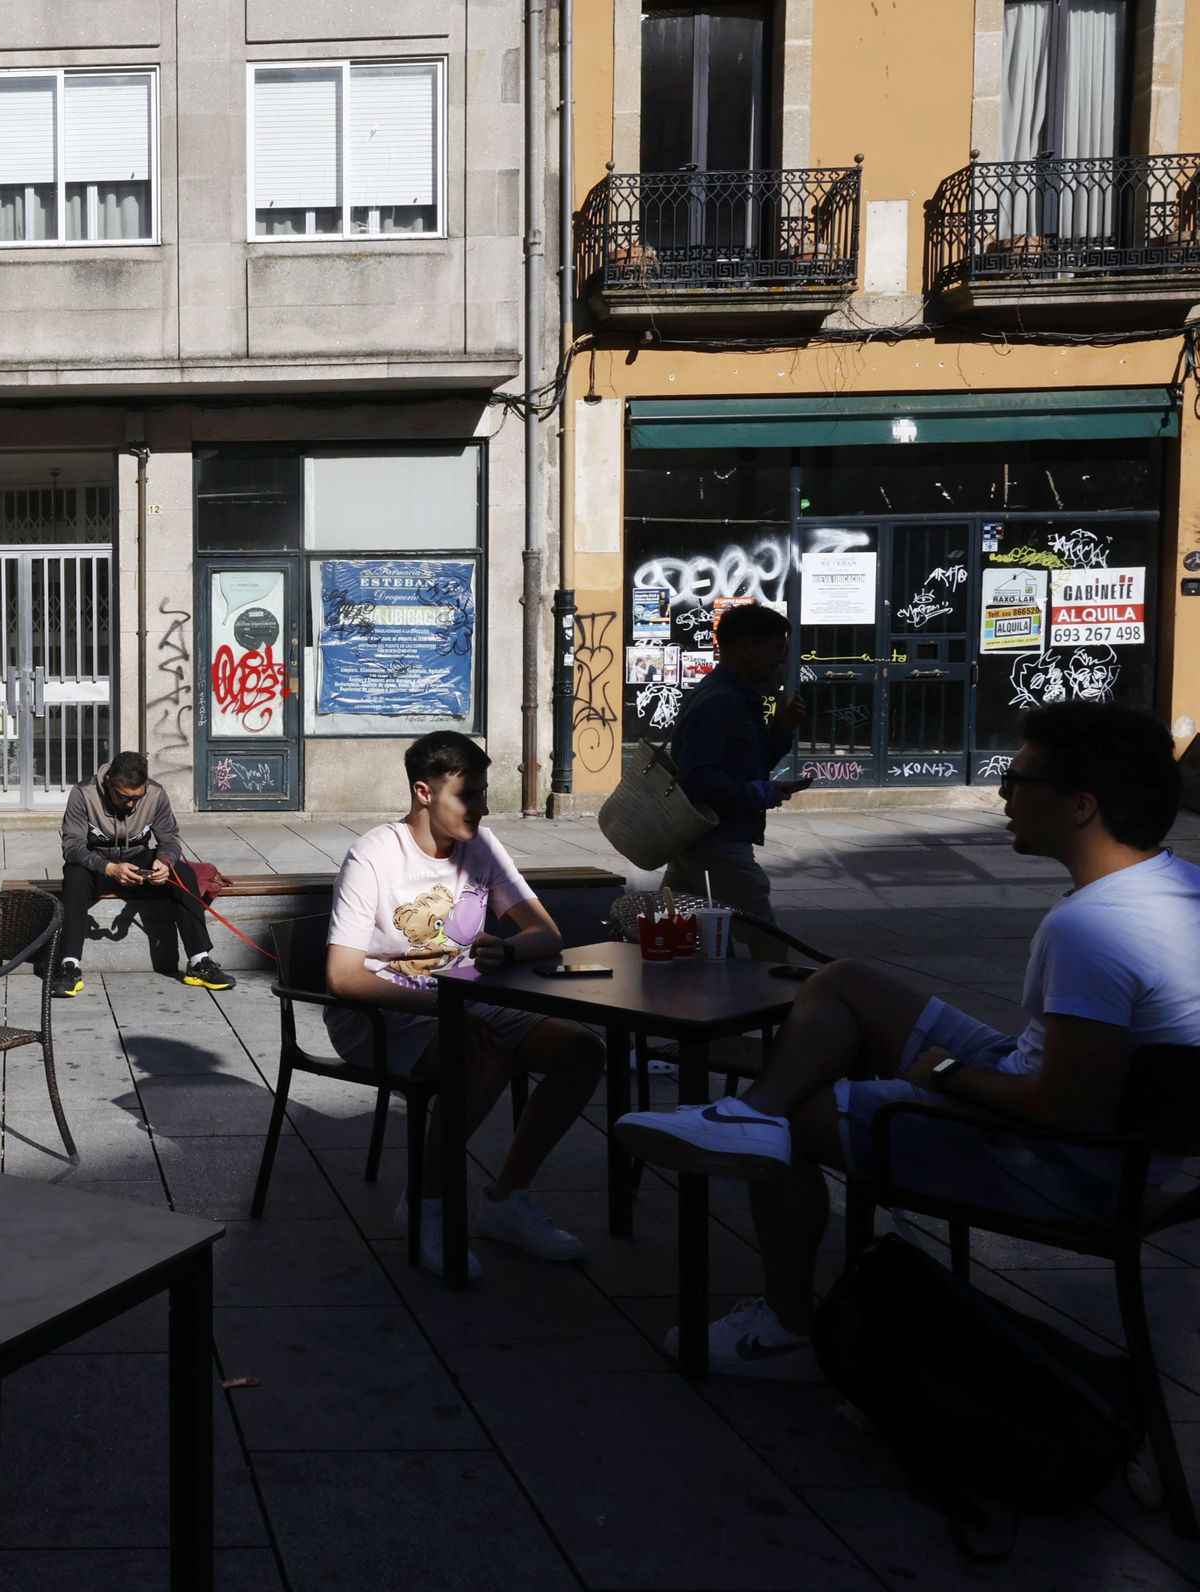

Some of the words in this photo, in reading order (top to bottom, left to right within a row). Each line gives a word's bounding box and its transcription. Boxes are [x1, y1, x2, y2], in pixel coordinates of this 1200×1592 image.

[150, 505, 160, 514] 12
[360, 577, 436, 588] ESTEBAN
[1057, 607, 1136, 622] ALQUILA
[997, 621, 1028, 633] ALQUILA
[1054, 628, 1080, 643] 693
[1085, 627, 1112, 642] 267
[1116, 626, 1141, 641] 498
